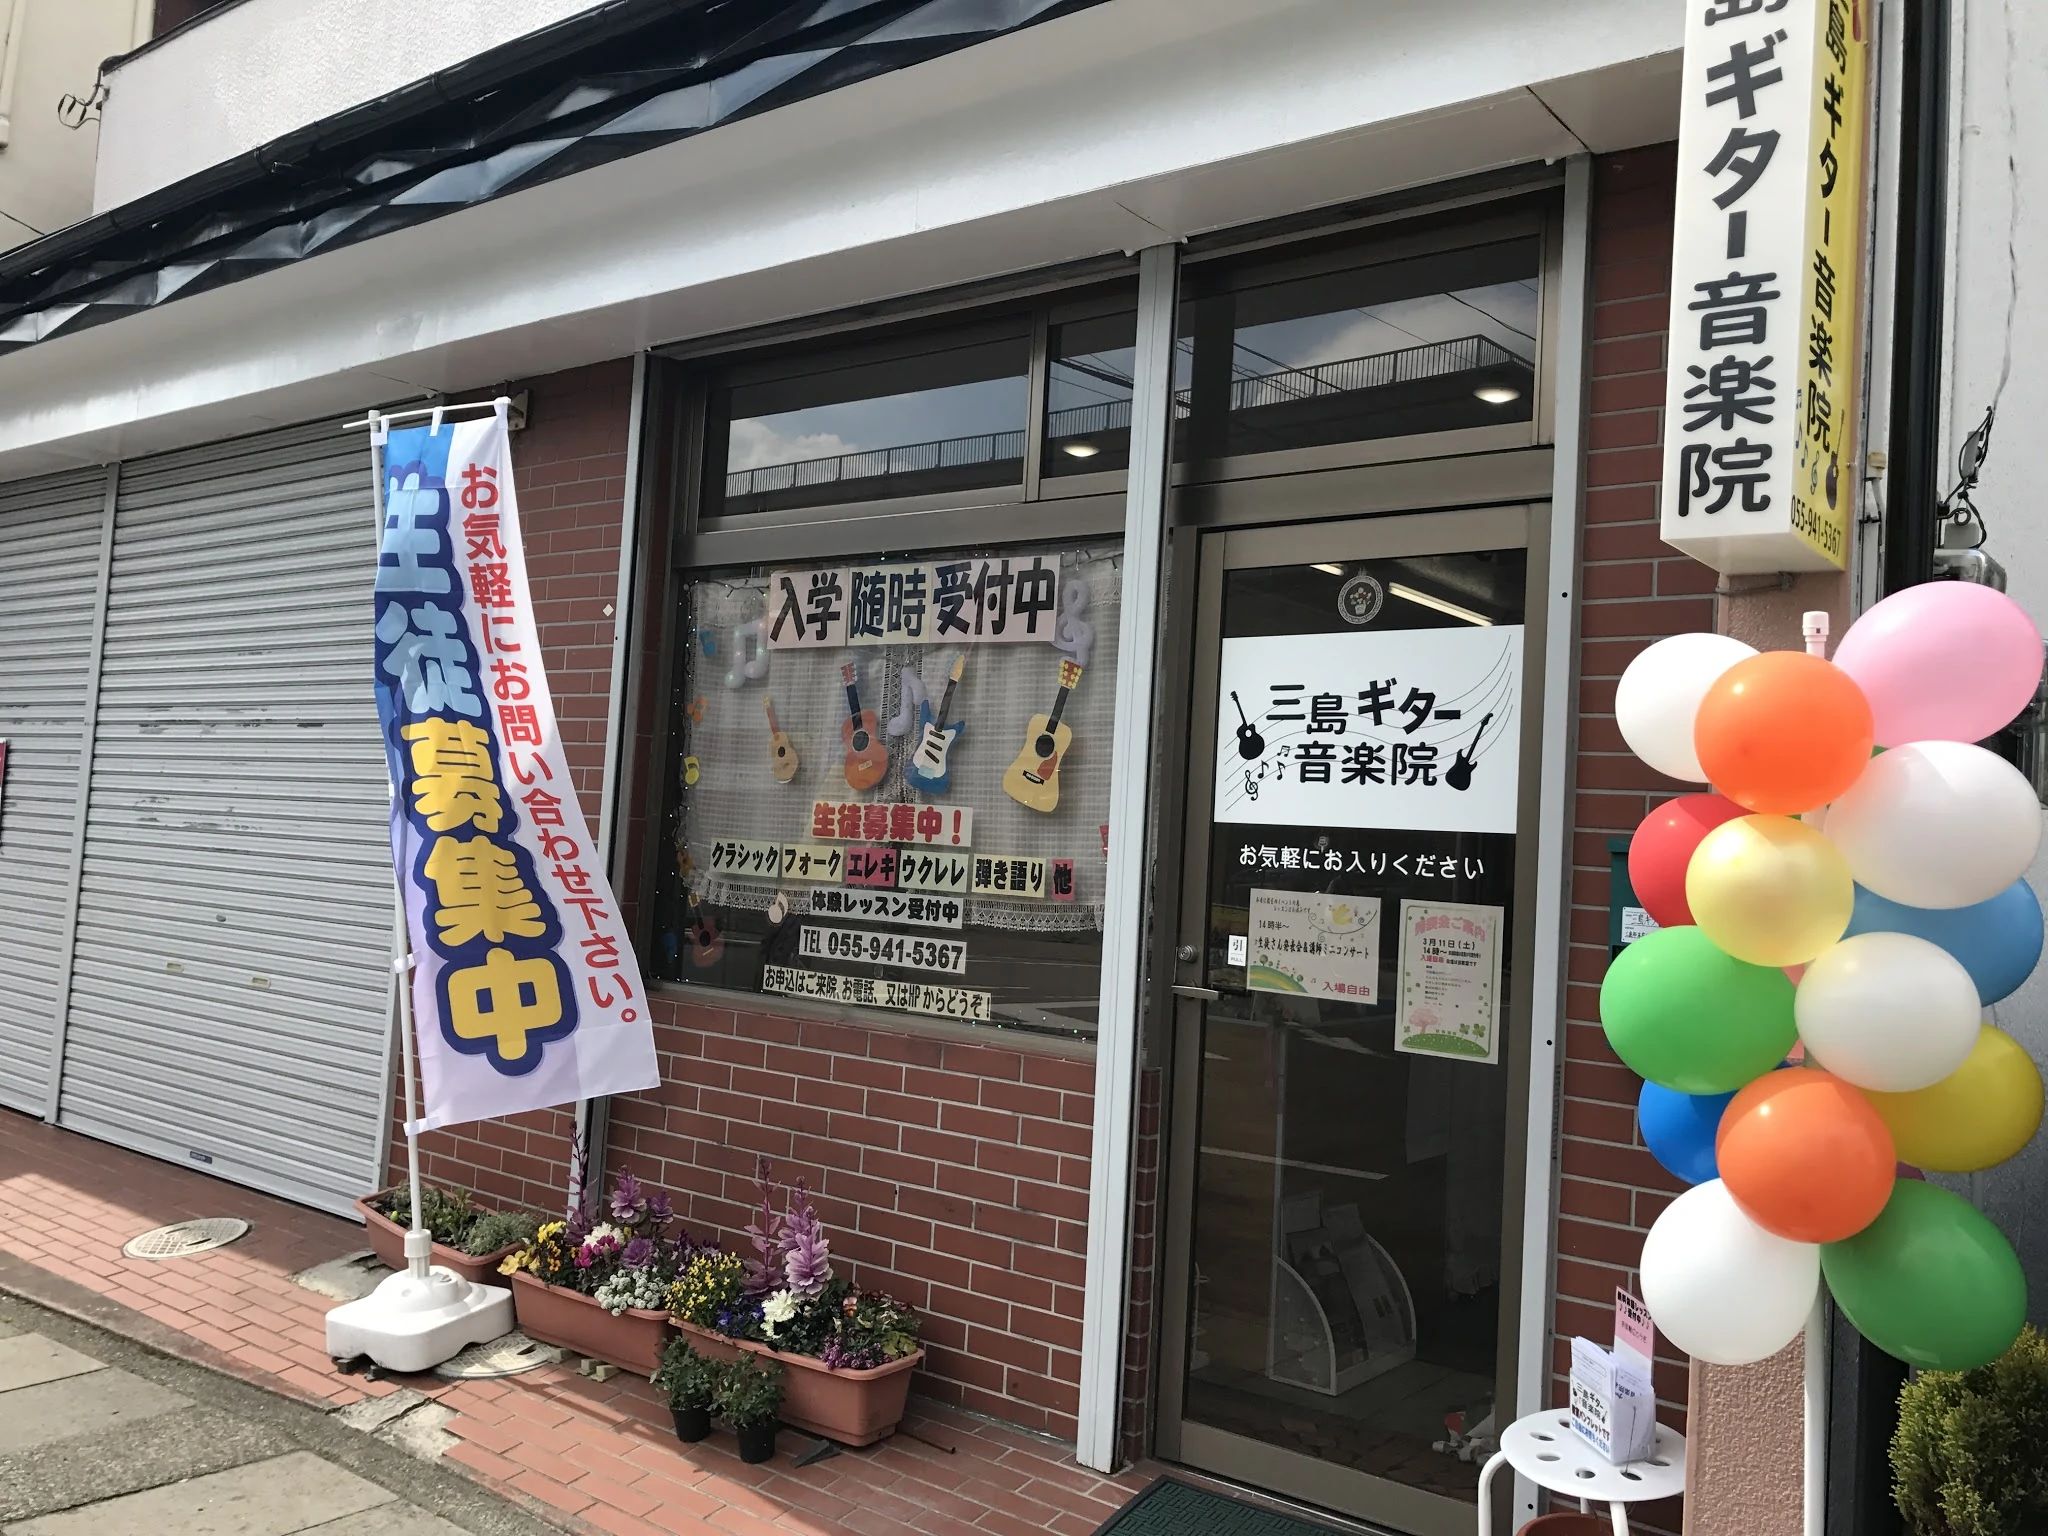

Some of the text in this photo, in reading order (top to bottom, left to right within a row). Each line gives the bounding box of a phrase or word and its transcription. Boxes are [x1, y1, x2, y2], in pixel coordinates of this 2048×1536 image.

[1807, 0, 1849, 453] 島ギター音楽院
[1791, 495, 1842, 557] 055-941-5367
[1266, 678, 1461, 735] 三島ギター
[375, 472, 562, 1060] 生徒募集中
[460, 463, 637, 1024] お気軽にお問い合わせ下さい。
[1294, 741, 1439, 787] 音楽院
[812, 802, 962, 845] 生徒募集中！
[711, 841, 1072, 895] クラシック フォーク エレキ ウクレレ 弾き語り 他
[1238, 844, 1485, 880] お気軽にお入りください
[811, 889, 959, 924] 体験レッスン受付中
[803, 928, 964, 970] TEL 055-941-5367
[1233, 939, 1243, 951] 引
[1321, 981, 1371, 997] 入場自由
